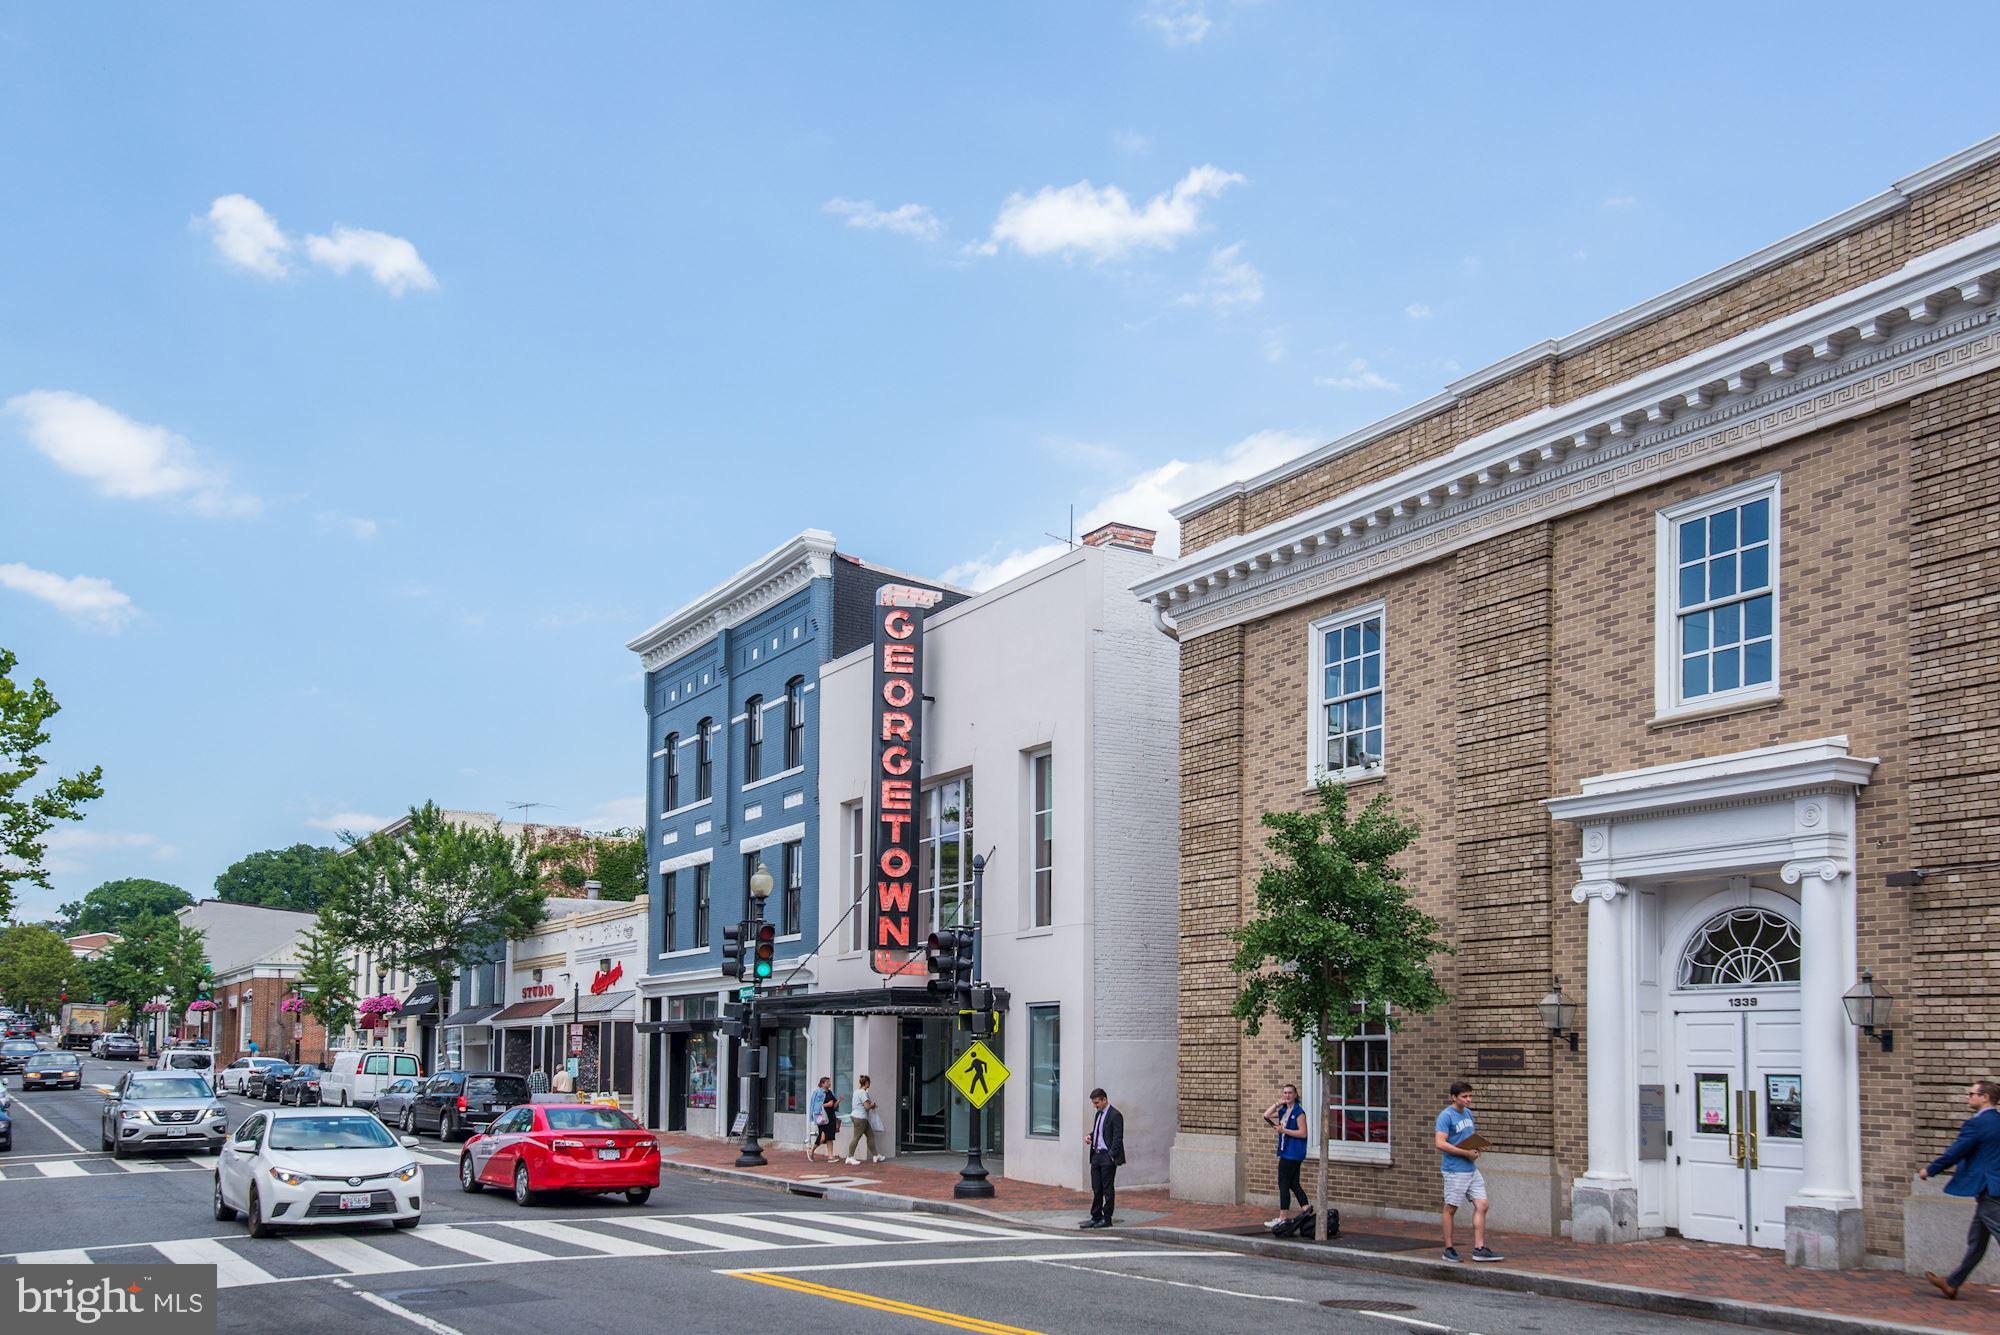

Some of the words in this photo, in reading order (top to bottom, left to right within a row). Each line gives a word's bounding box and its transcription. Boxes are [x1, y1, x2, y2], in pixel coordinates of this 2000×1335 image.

[878, 609, 915, 947] GEORGETOWN
[521, 984, 554, 999] STUDIO
[1728, 997, 1758, 1008] 1339
